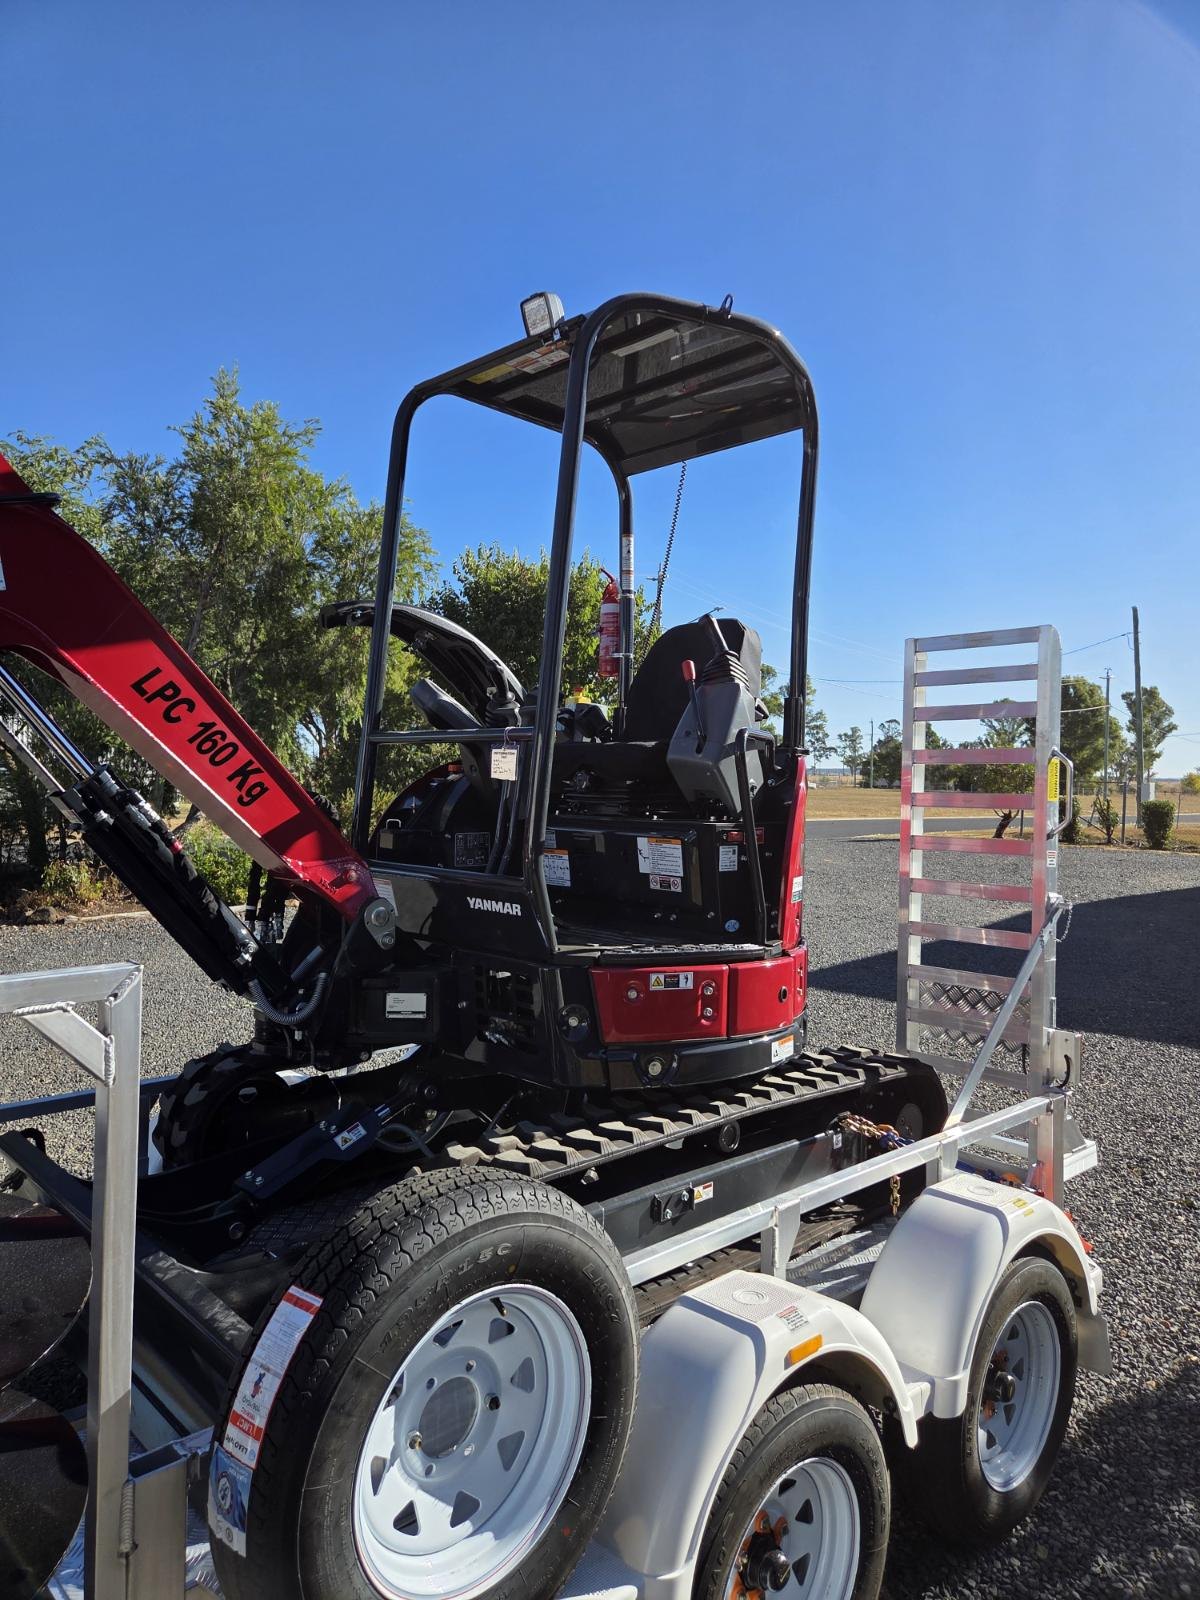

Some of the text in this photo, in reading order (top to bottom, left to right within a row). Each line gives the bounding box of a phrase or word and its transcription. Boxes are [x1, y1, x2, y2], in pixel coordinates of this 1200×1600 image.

[130, 667, 270, 807] LPC 160 Kg
[466, 897, 522, 916] YANMAR
